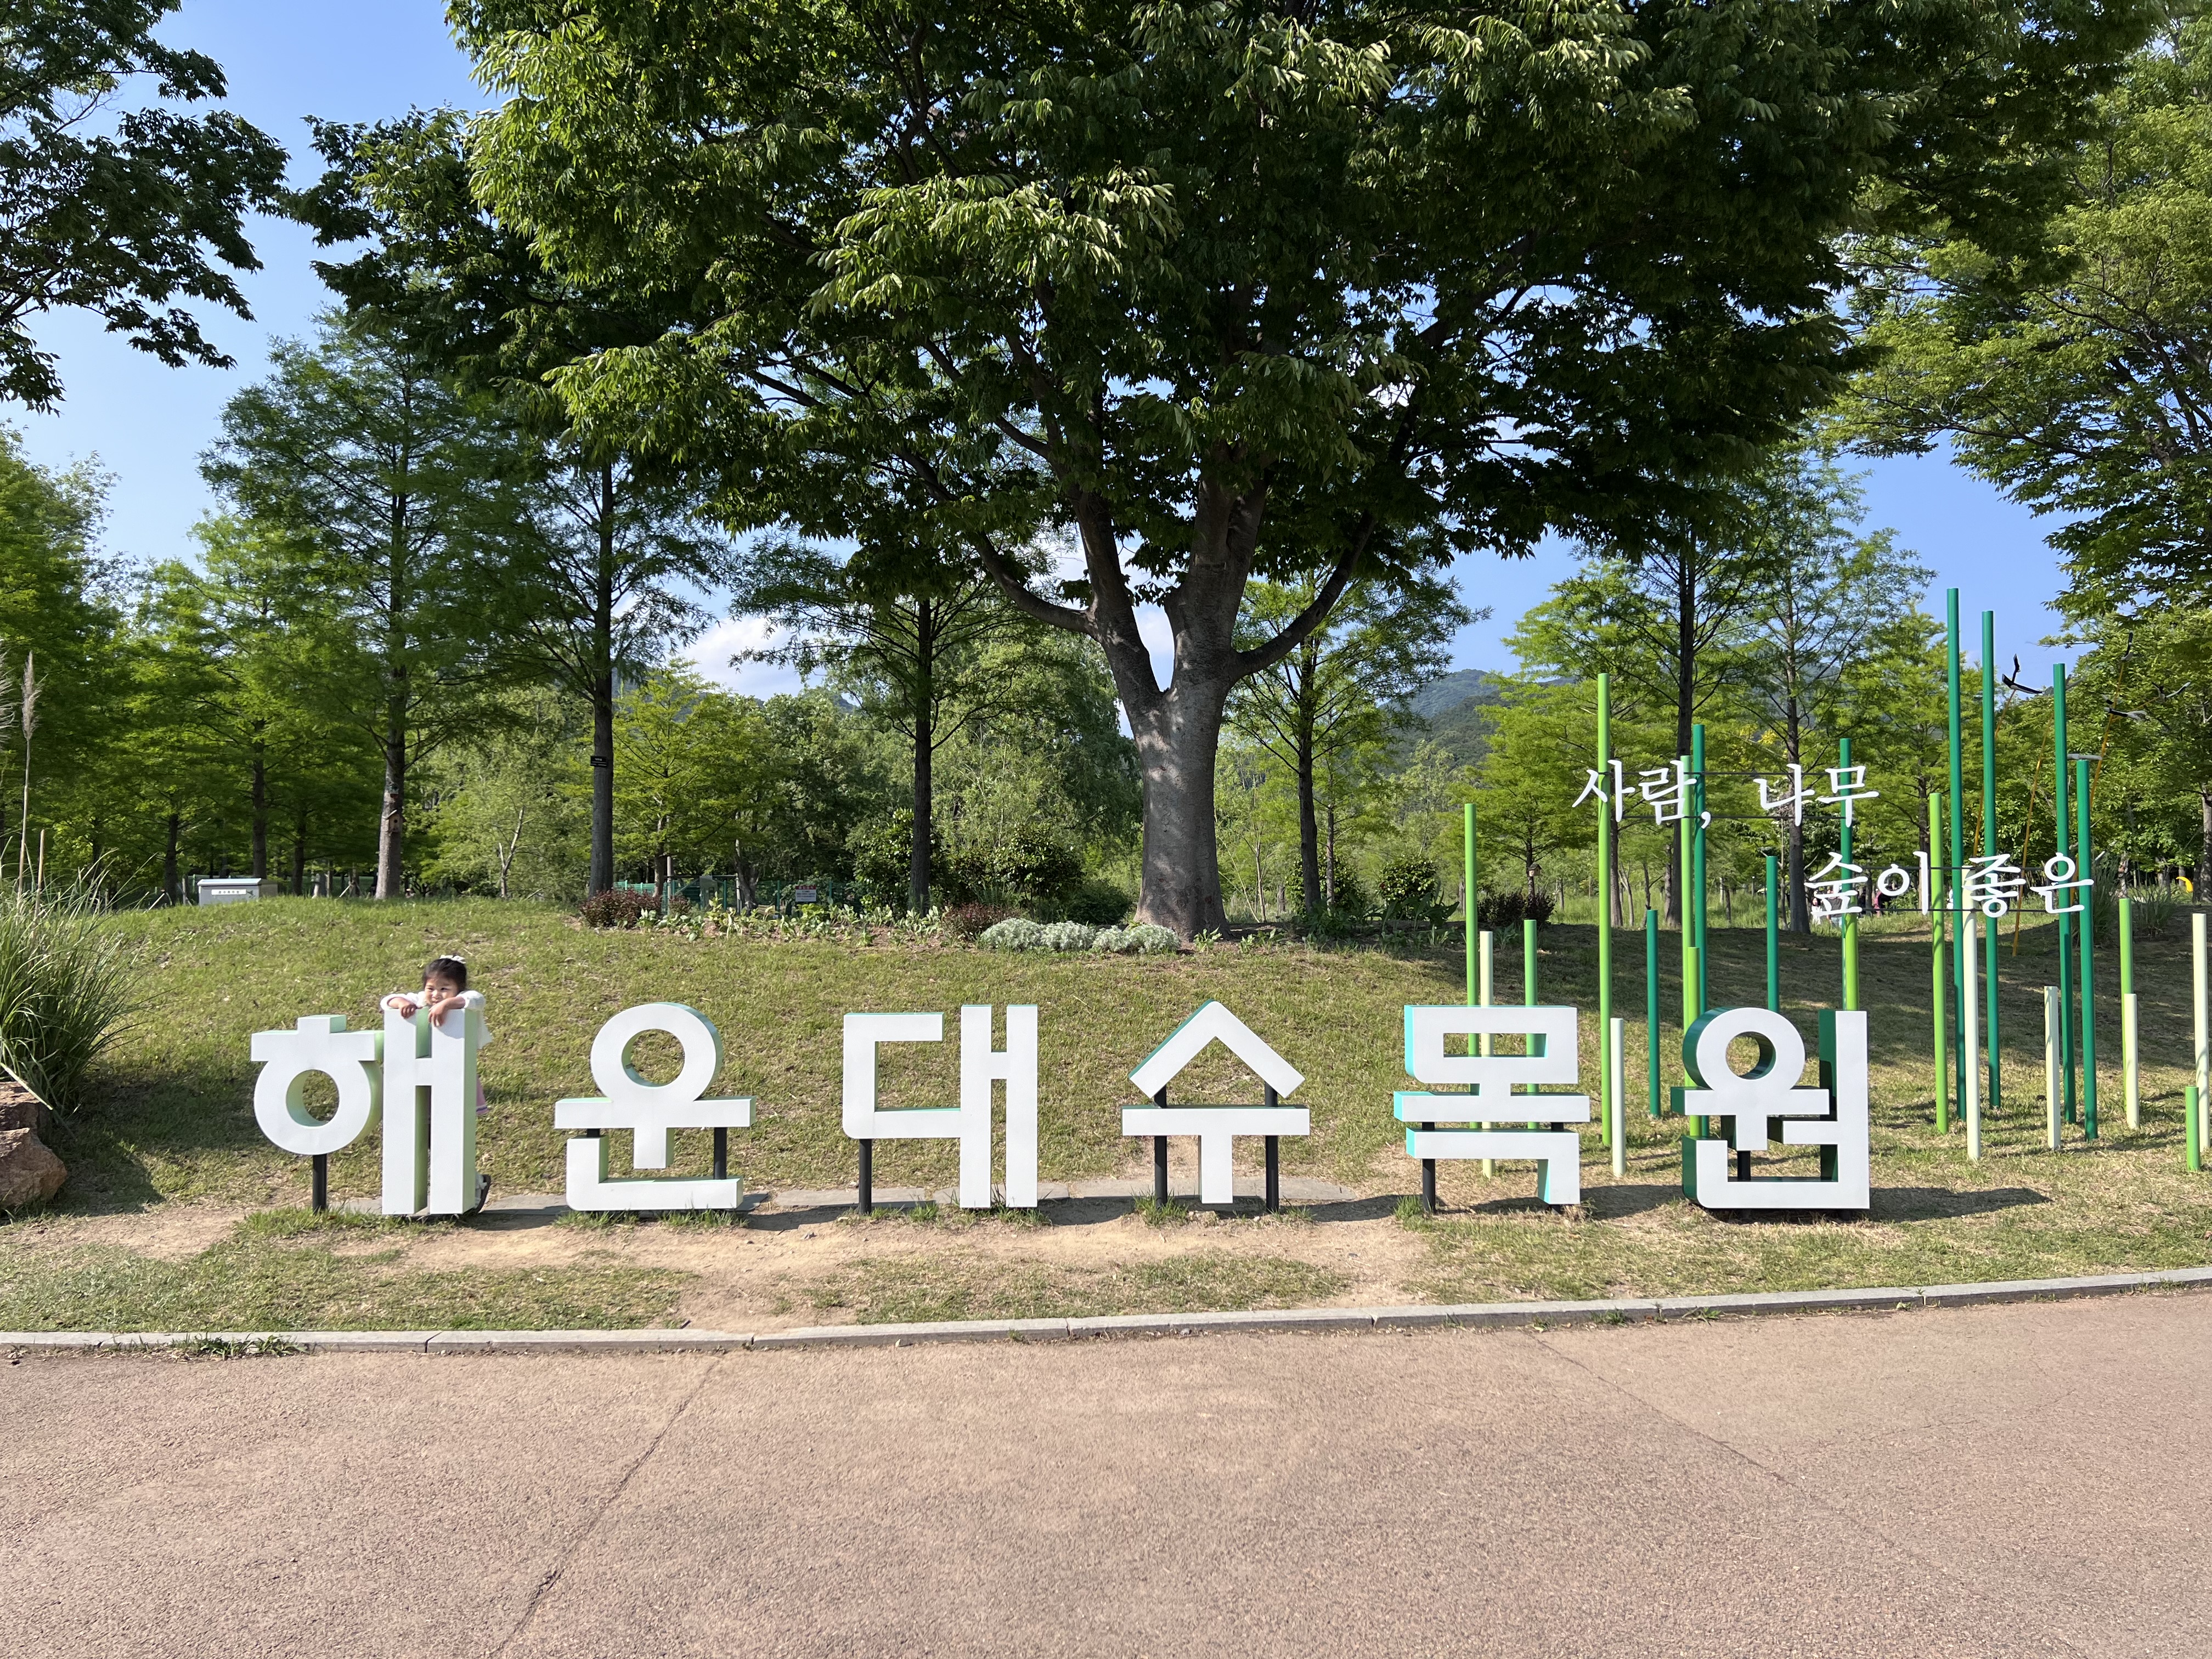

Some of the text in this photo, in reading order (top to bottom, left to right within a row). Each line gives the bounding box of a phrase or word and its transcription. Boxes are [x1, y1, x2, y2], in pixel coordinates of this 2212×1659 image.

[1571, 759, 1880, 830] 사람, 나무
[1961, 852, 2095, 918] 좋은
[250, 1000, 1870, 1215] 해운대수목원
